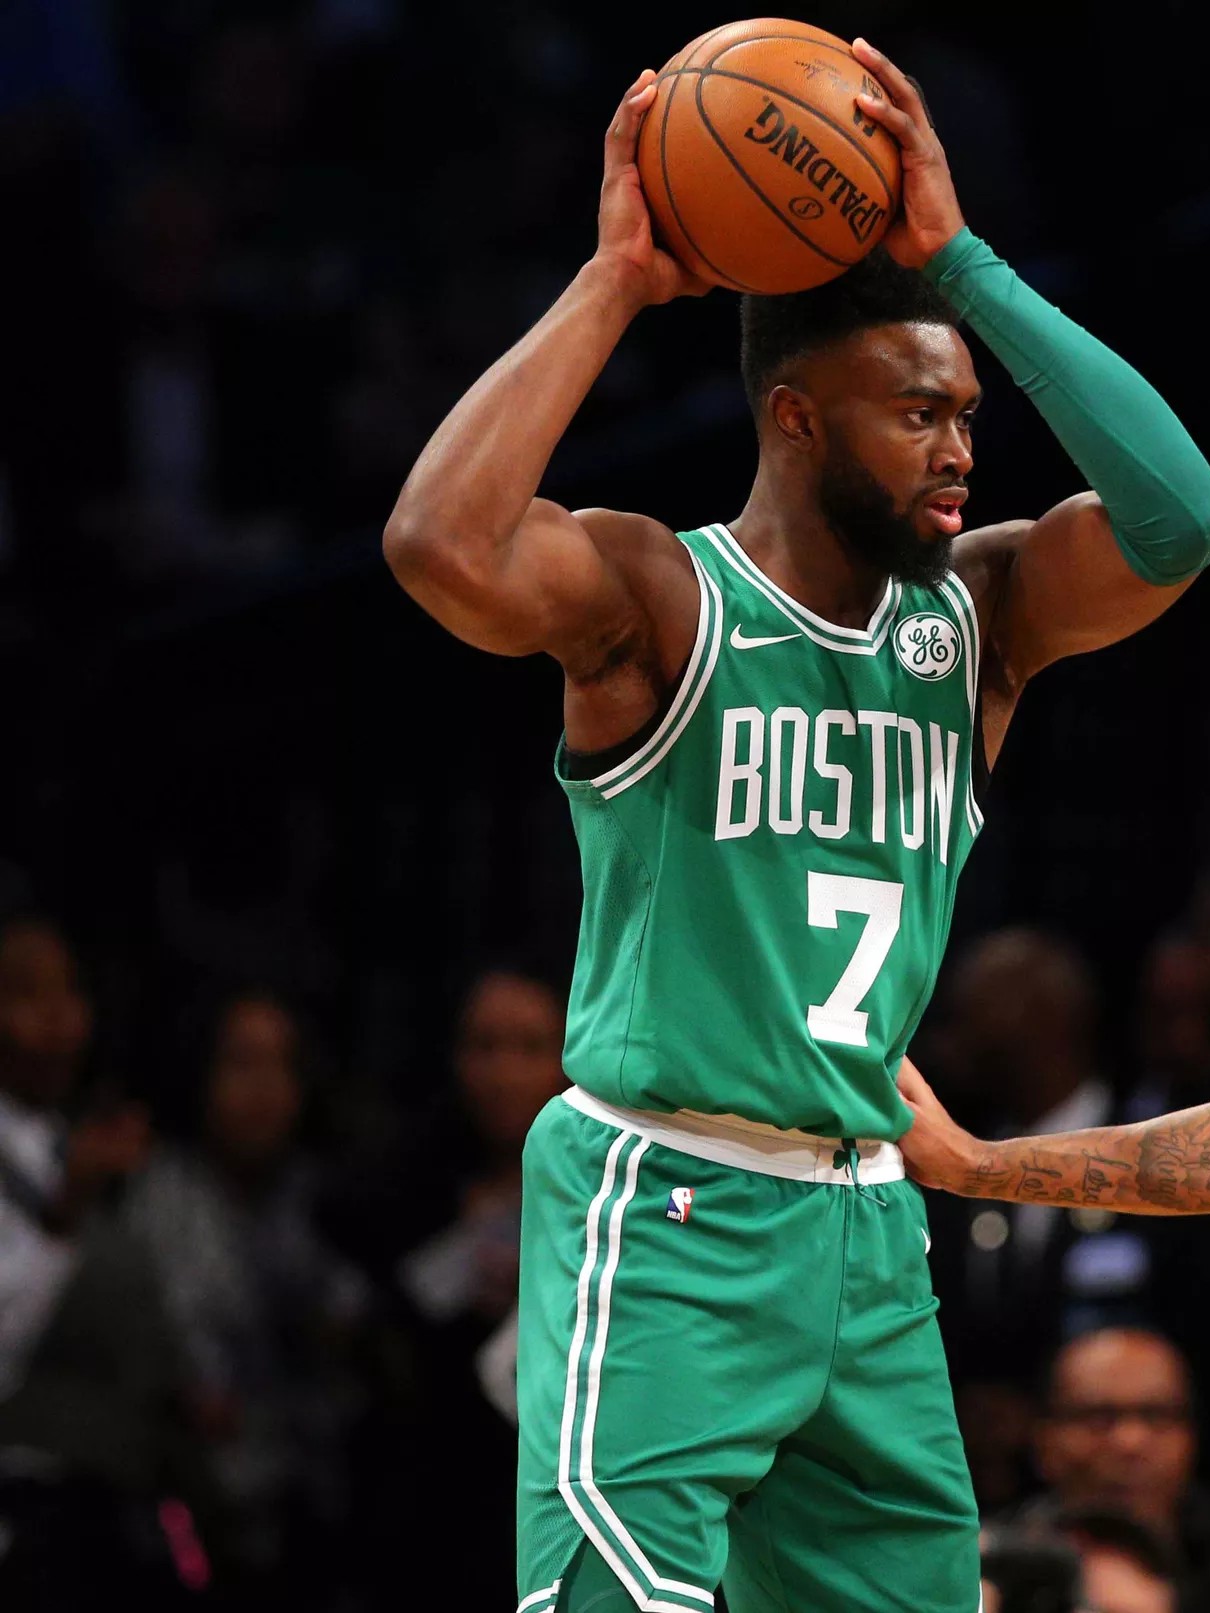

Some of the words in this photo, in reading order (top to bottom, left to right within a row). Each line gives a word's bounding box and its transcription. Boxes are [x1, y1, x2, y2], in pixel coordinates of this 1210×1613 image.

[744, 101, 887, 245] SPALDING
[715, 706, 959, 866] BOSTON
[806, 870, 904, 1048] 7
